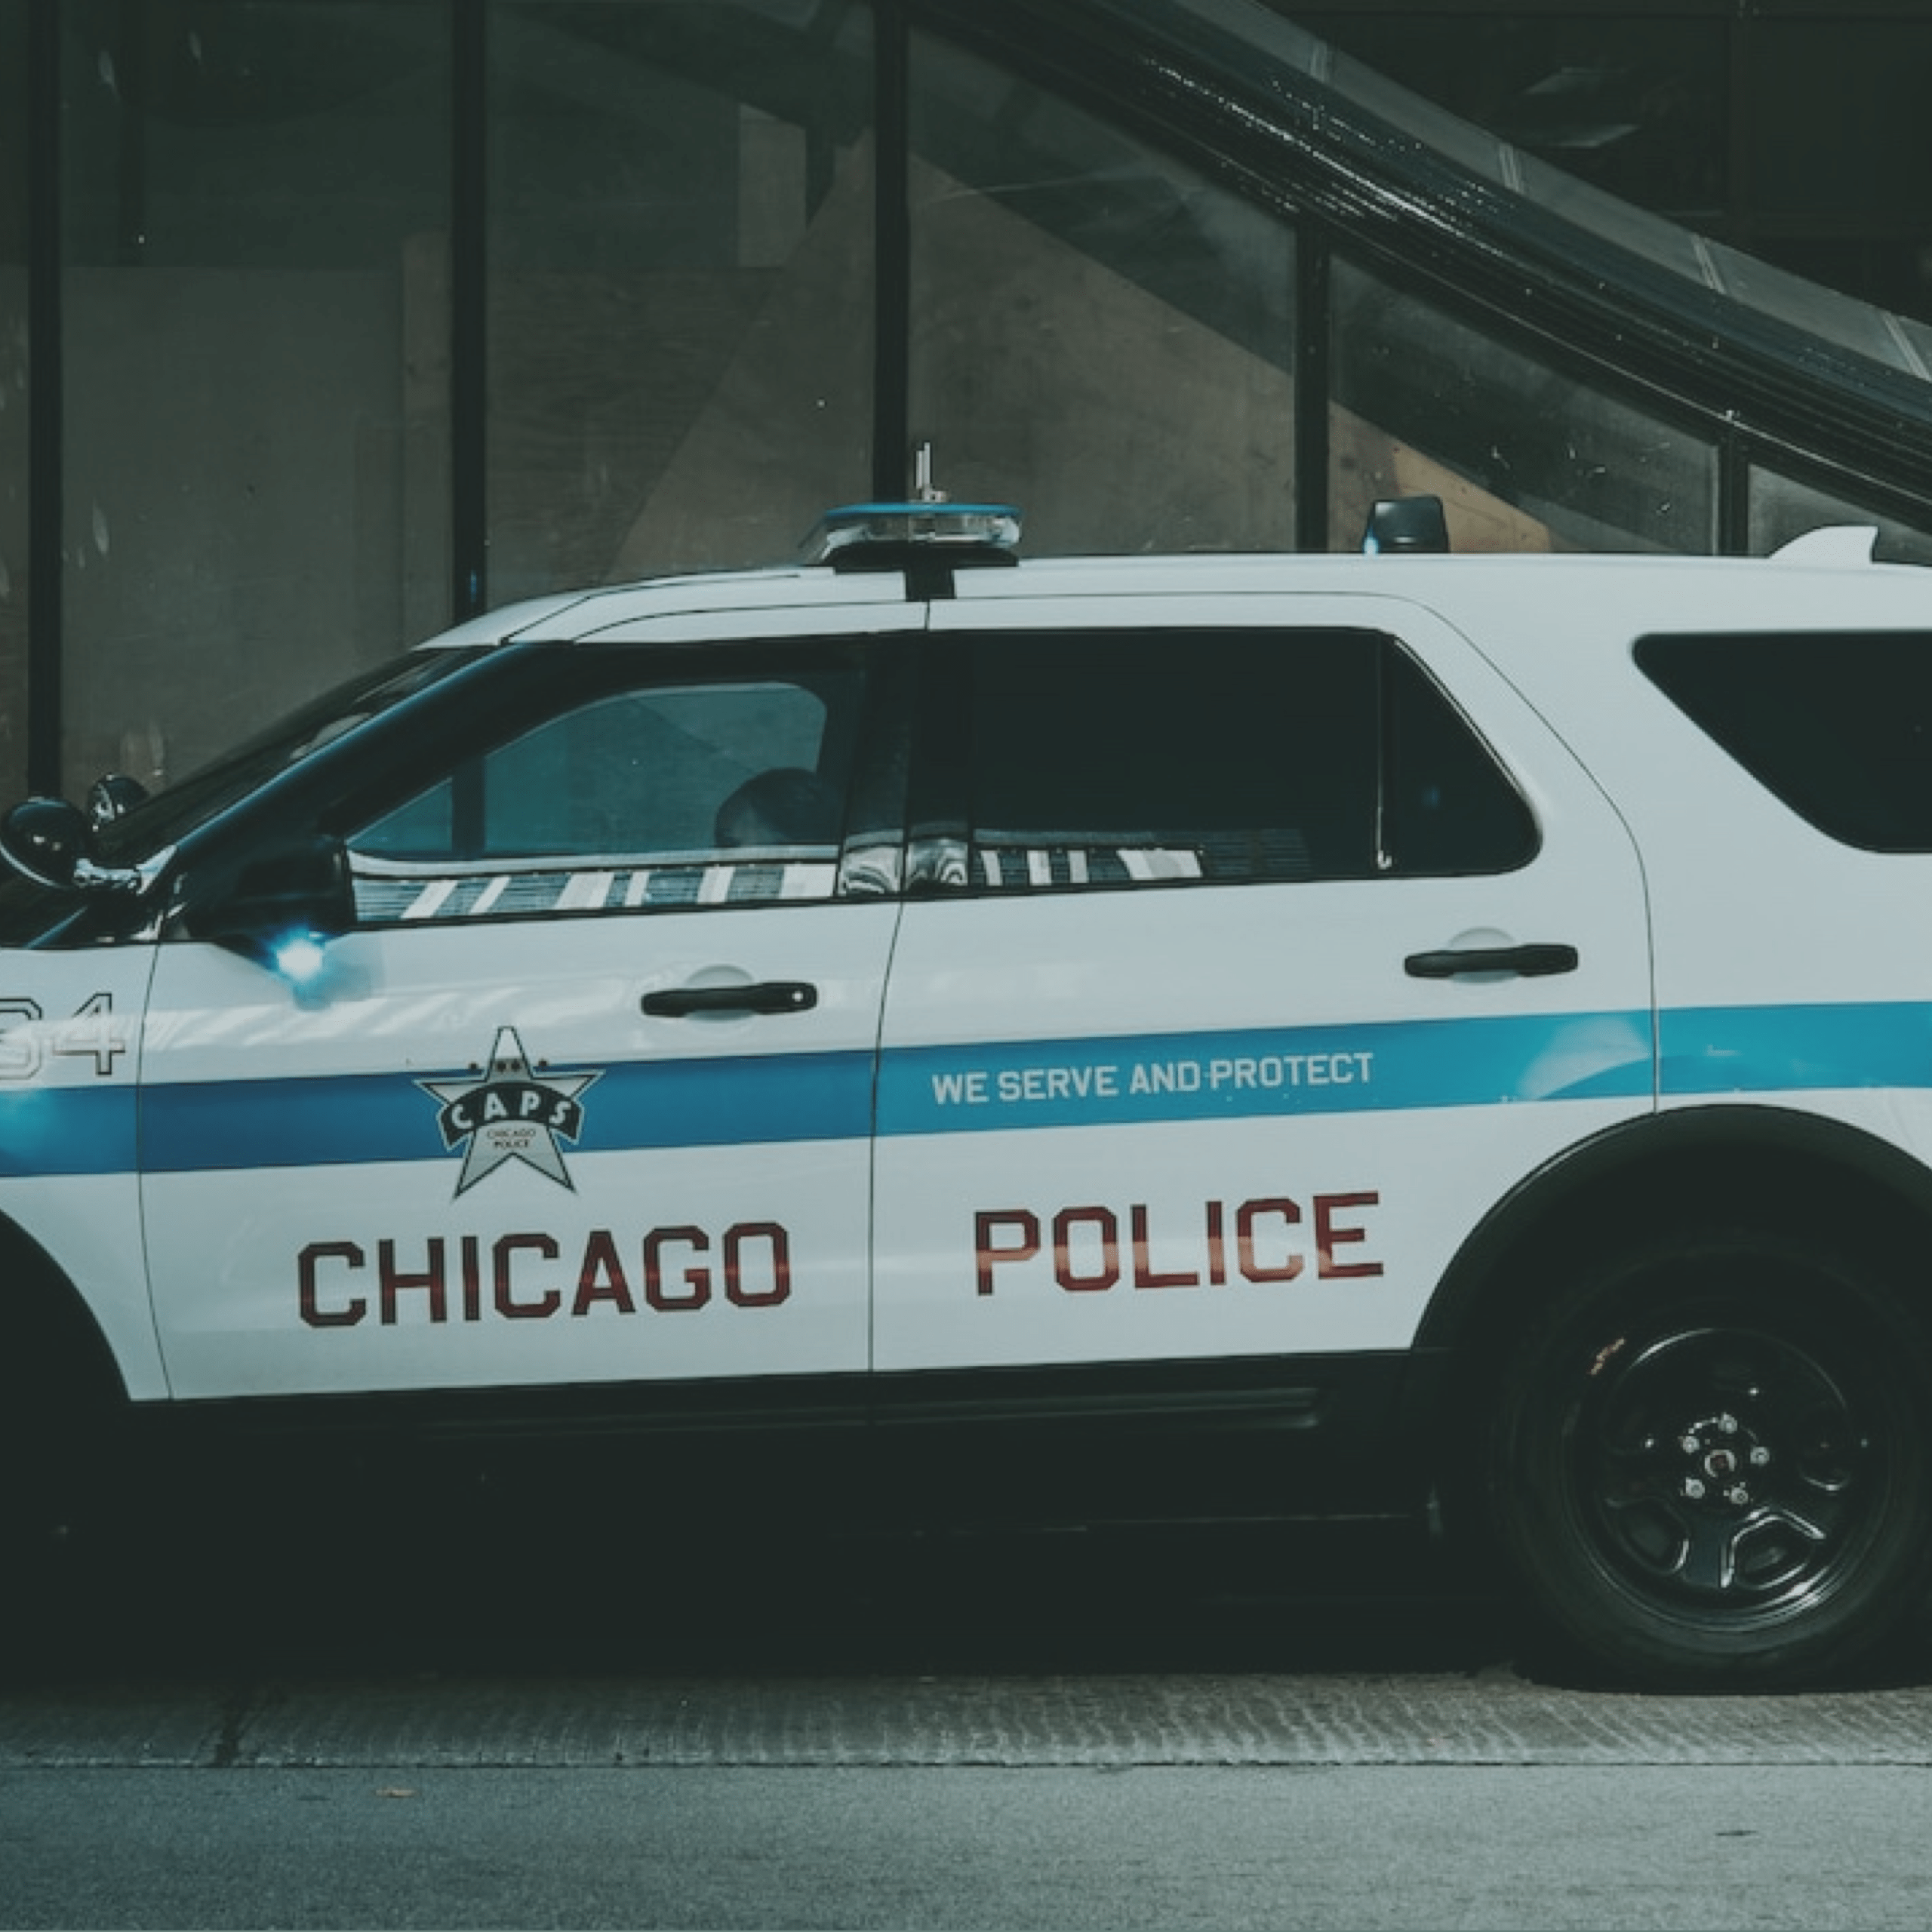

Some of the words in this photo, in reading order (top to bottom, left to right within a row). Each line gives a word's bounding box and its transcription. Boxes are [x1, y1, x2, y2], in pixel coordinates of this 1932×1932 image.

[932, 1071, 989, 1105] WE
[998, 1064, 1119, 1100] SERVE
[1130, 1060, 1201, 1094] AND
[1210, 1052, 1374, 1089] PROTECT
[451, 1090, 571, 1129] CAPS
[298, 1222, 792, 1328] CHICAGO
[974, 1190, 1384, 1296] POLICE
